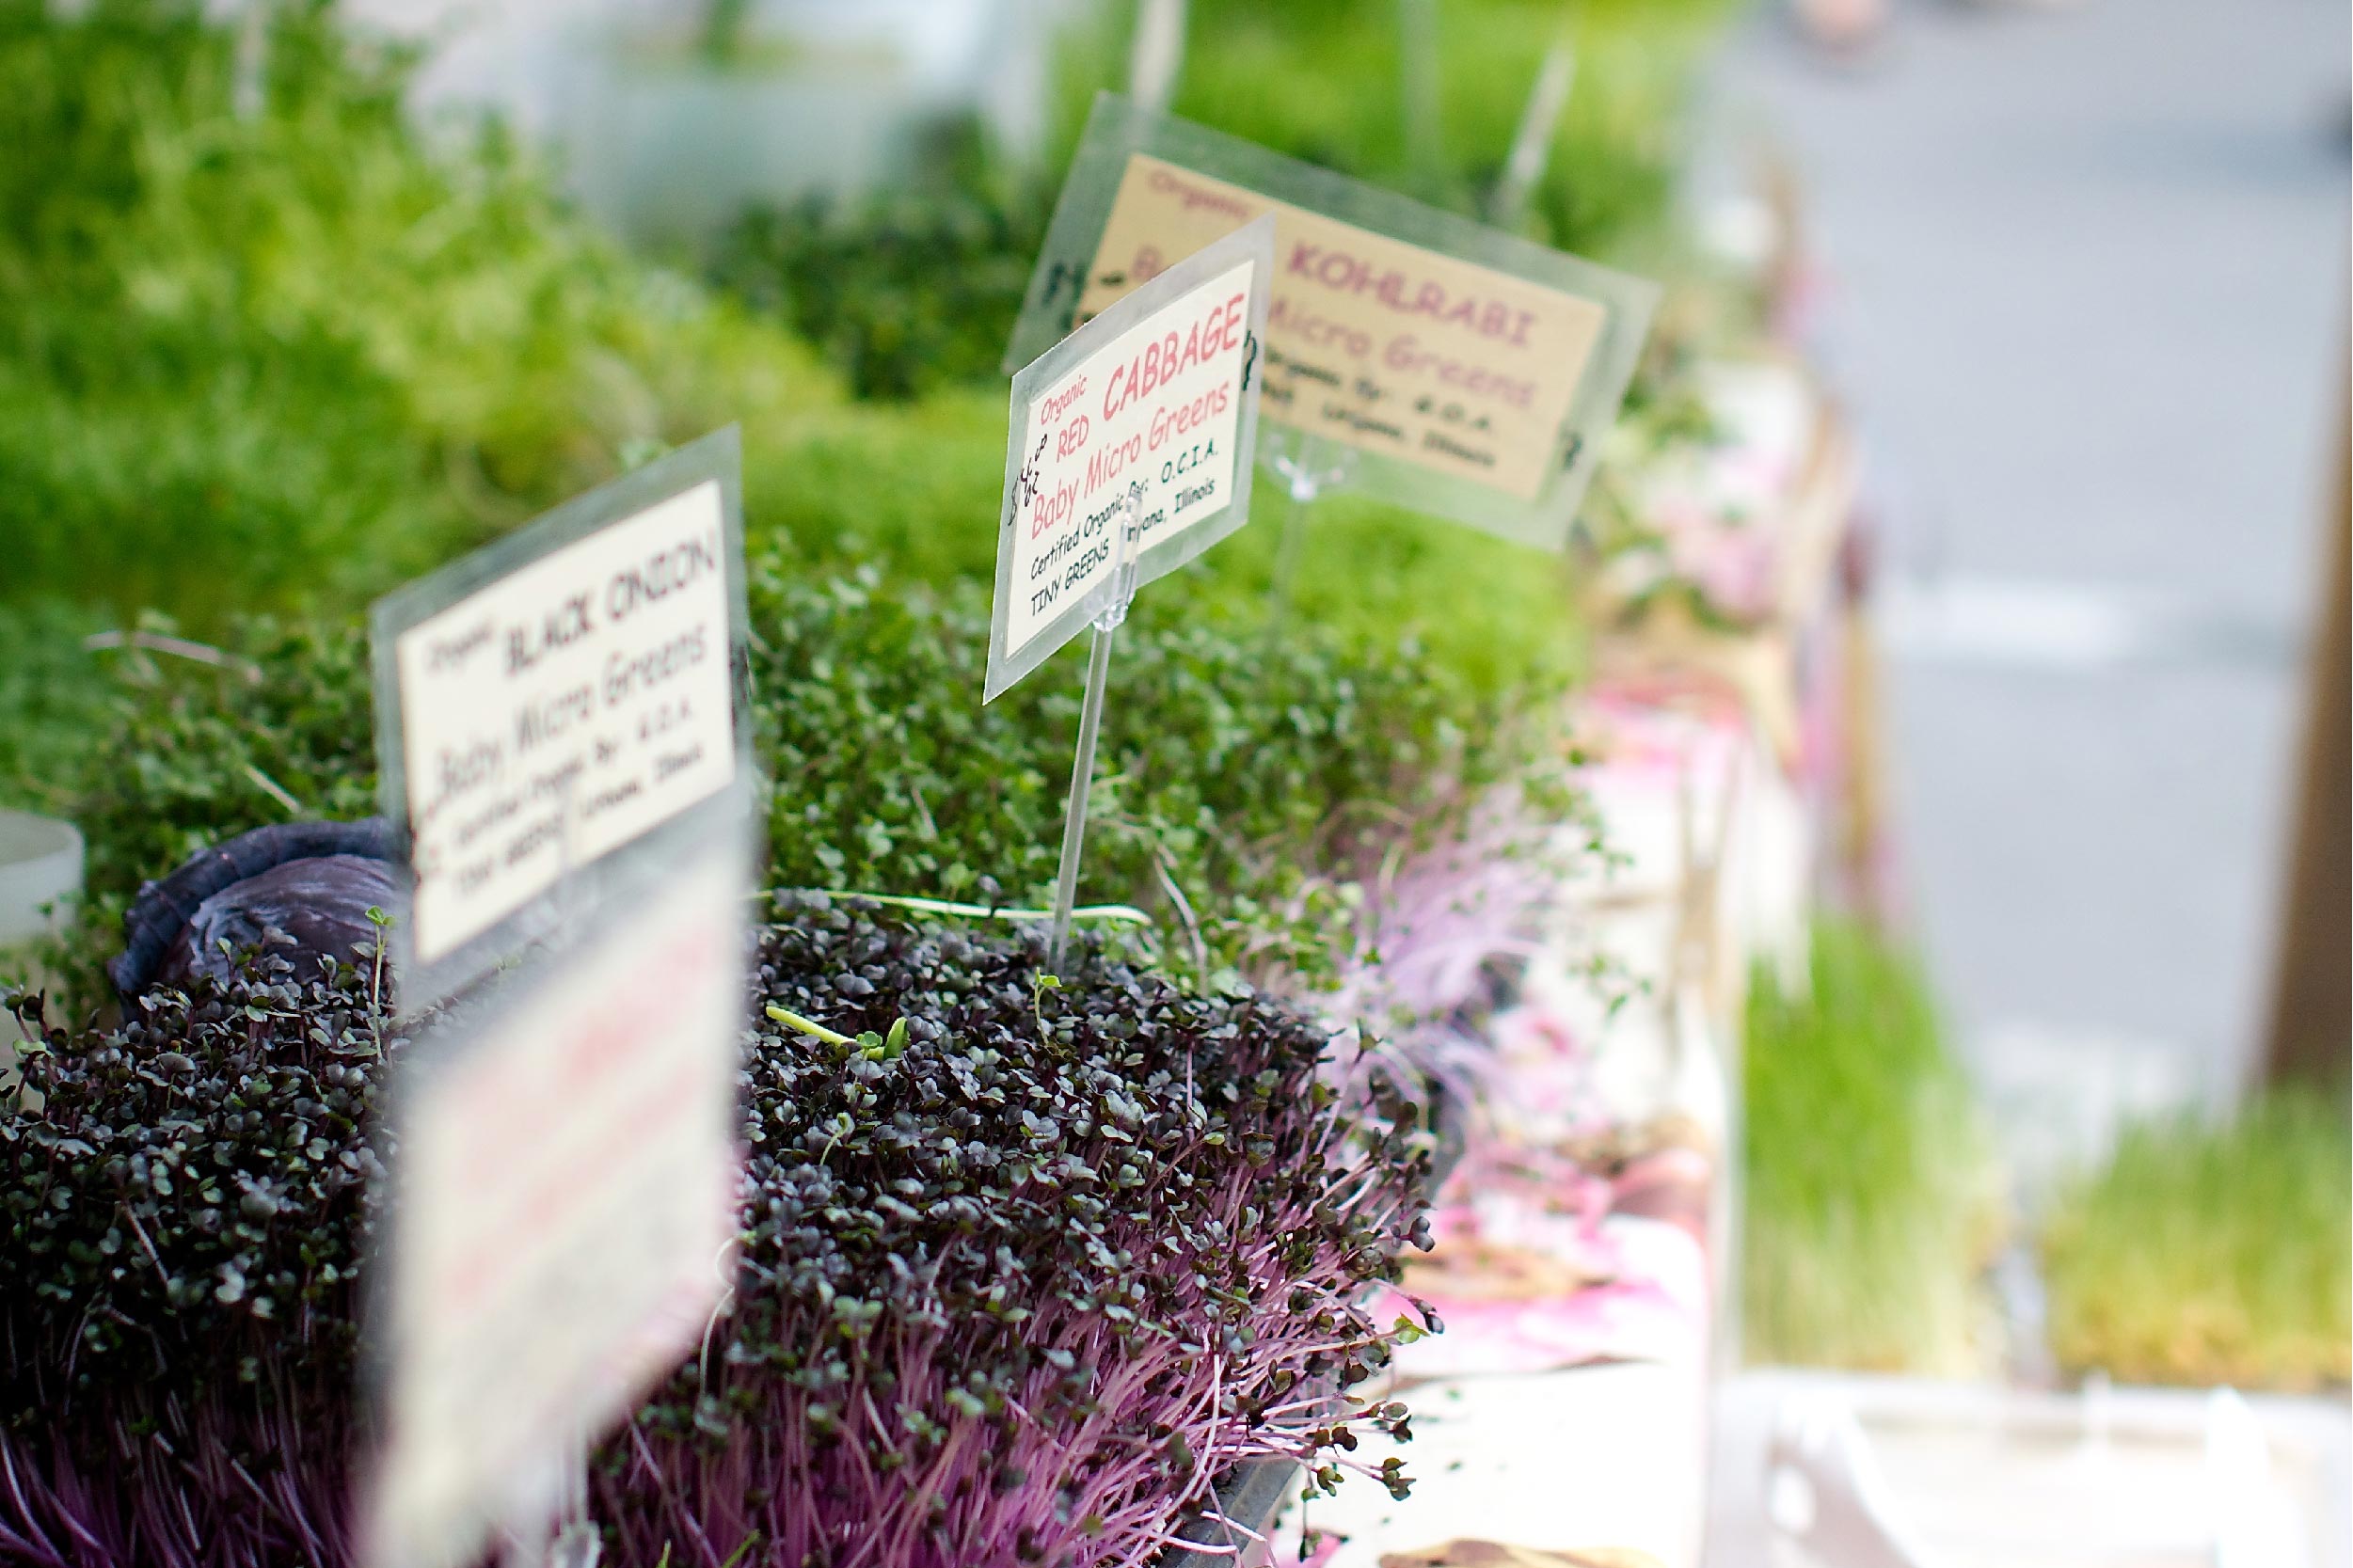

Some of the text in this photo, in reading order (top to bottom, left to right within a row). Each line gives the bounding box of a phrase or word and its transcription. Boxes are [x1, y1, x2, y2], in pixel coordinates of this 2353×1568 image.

[1287, 240, 1535, 348] KOHLRABI
[1041, 373, 1087, 425] Organic
[1057, 414, 1089, 463] RED
[1104, 293, 1245, 421] CABBAGE
[1383, 333, 1536, 407] Greens
[1030, 521, 1081, 580] Certified
[1084, 492, 1124, 537] Organic
[1161, 437, 1218, 483] O.C.I.A.
[1031, 477, 1080, 540] Baby
[1084, 434, 1141, 499] Micro
[1149, 381, 1230, 451] Greens
[505, 534, 716, 676] BLACK ONION
[1031, 575, 1061, 616] TINY
[1064, 537, 1109, 591] GREENS
[1173, 477, 1216, 514] Illinois
[602, 622, 706, 707] Greens
